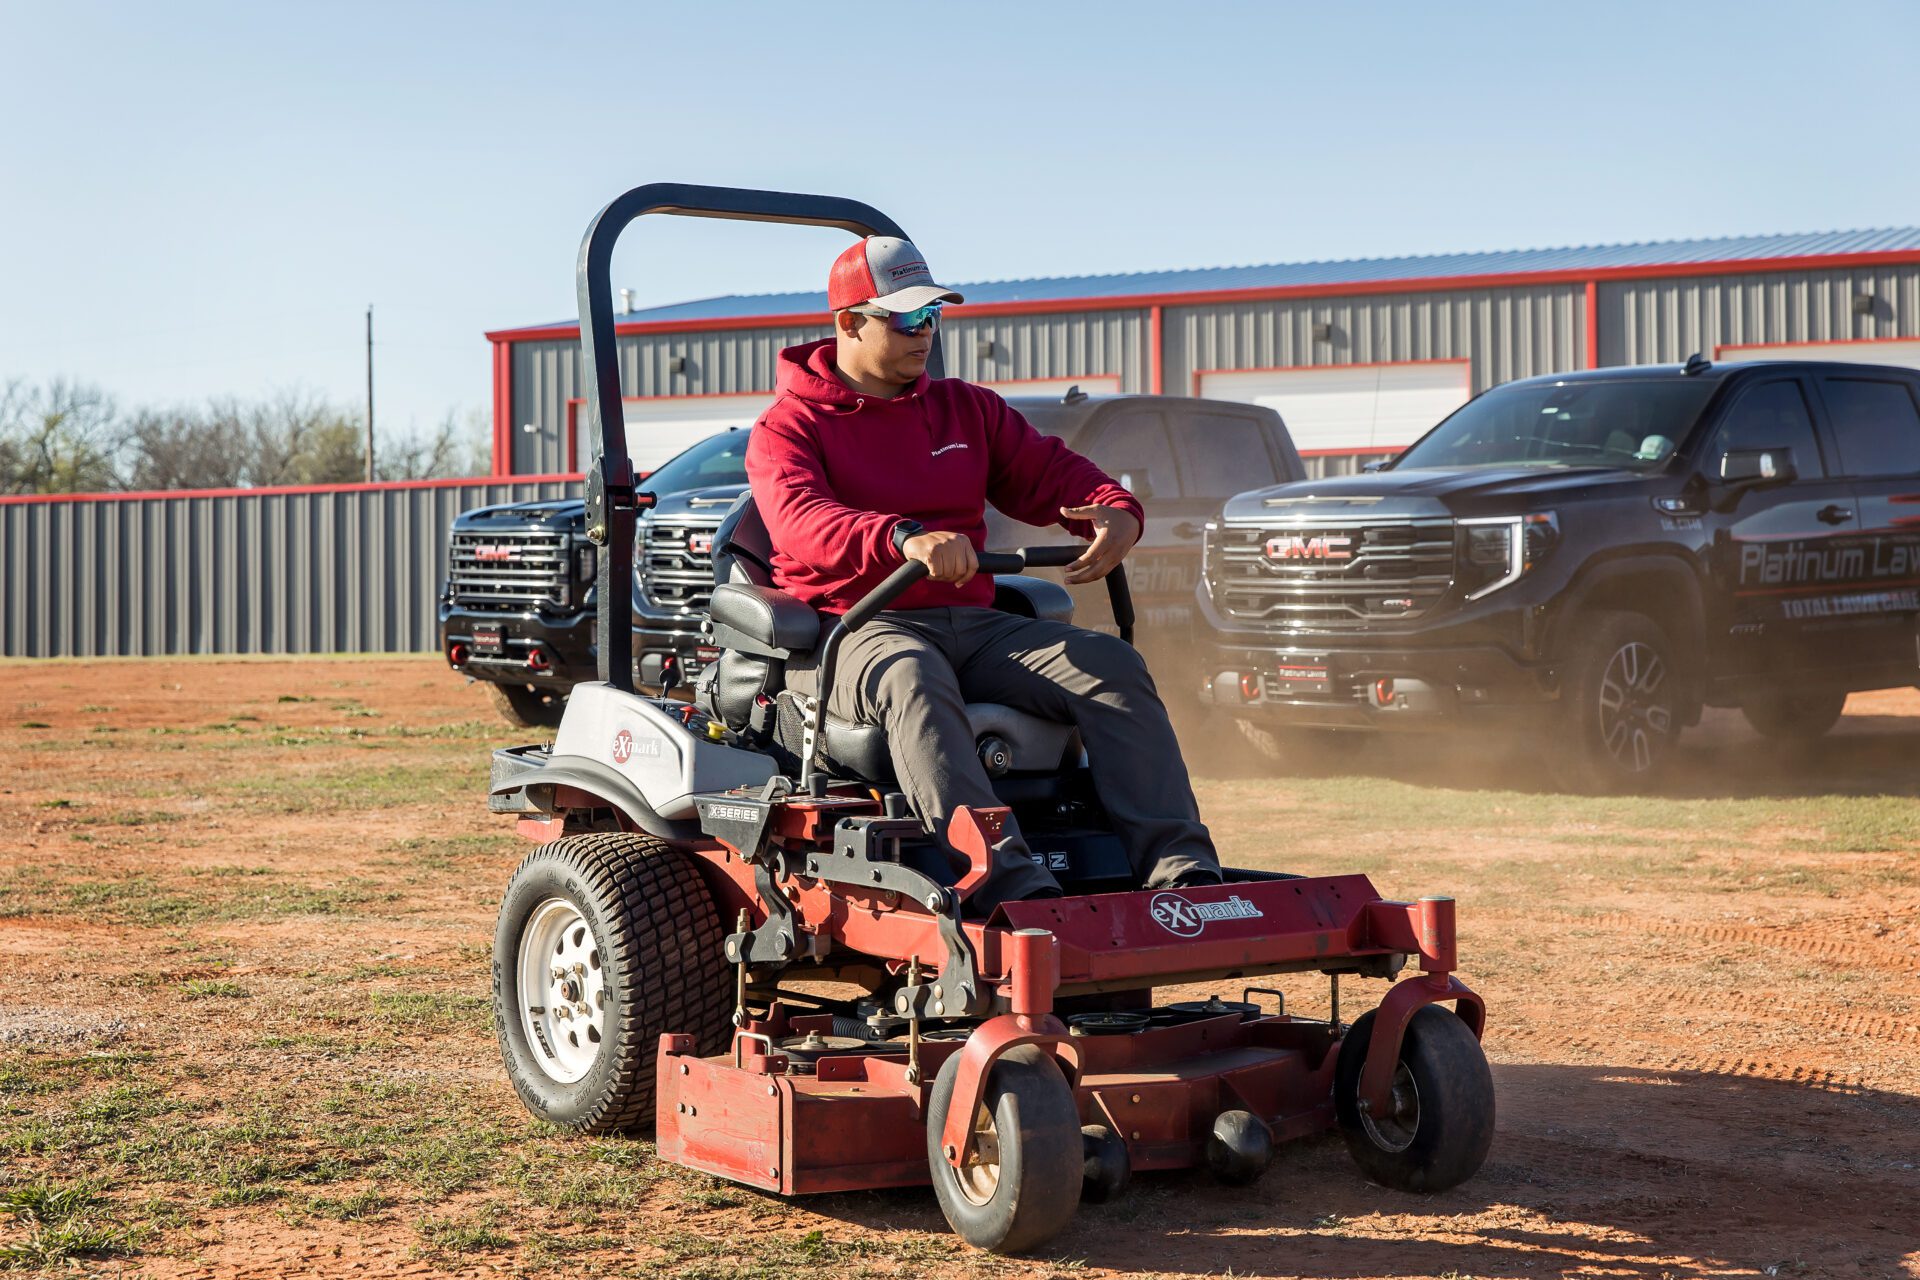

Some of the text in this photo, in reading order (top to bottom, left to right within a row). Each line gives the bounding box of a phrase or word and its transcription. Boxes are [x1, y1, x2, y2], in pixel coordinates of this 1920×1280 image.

[475, 545, 521, 561] GMC
[1266, 537, 1351, 559] GMC
[1739, 541, 1864, 585] Platinum
[1781, 597, 1831, 619] TOTAL
[612, 734, 660, 759] eXmark
[1152, 896, 1263, 929] eXmark
[565, 878, 614, 1002] CARLISLE
